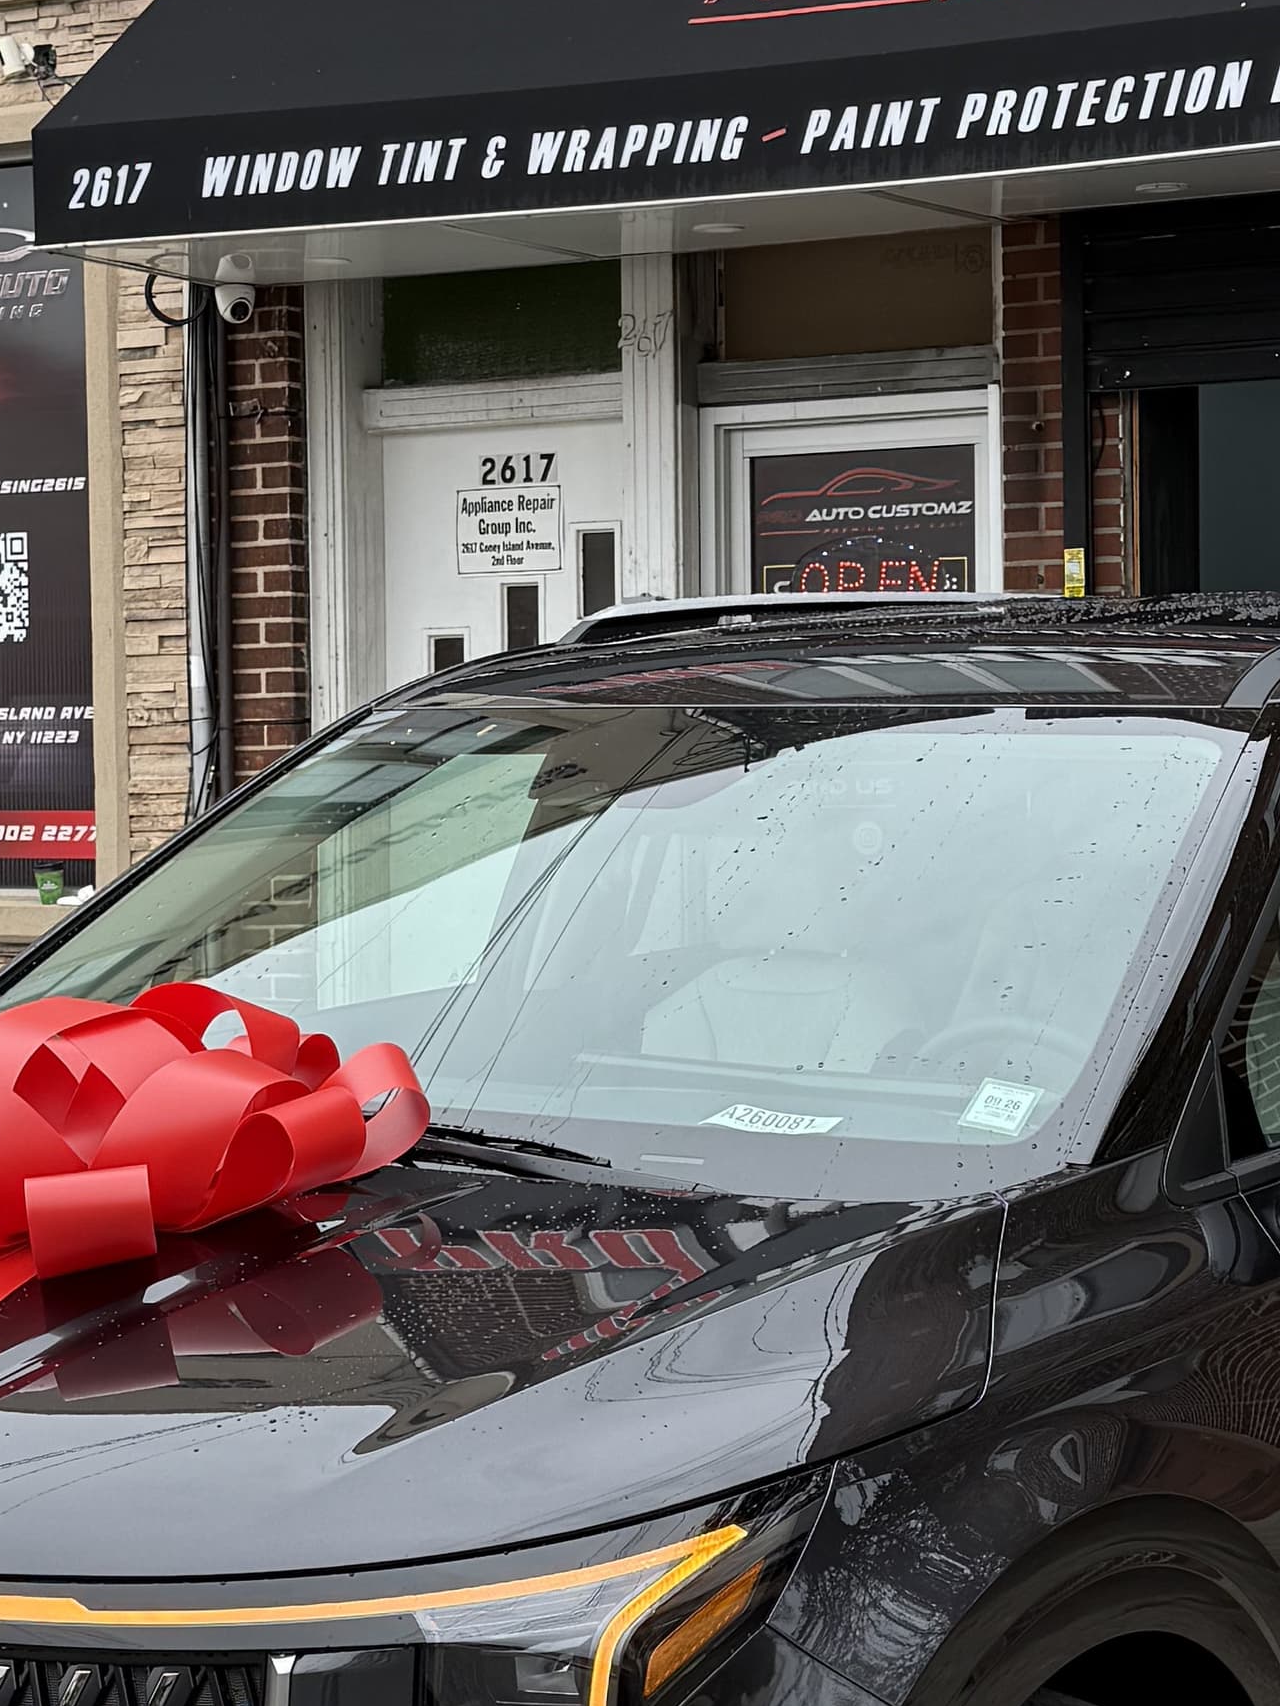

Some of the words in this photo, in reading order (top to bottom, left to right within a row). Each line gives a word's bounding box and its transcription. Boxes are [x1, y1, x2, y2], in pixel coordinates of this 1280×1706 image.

[201, 145, 362, 199] WINDOW
[376, 137, 467, 186] TINT
[479, 134, 503, 180] &
[526, 115, 751, 176] WRAPPING
[798, 96, 942, 154] PAINT
[956, 57, 1255, 137] PROTECTION
[68, 161, 152, 209] 2617
[481, 453, 555, 485] 2617
[461, 496, 514, 517] Appliance
[517, 493, 557, 513] Repair
[805, 507, 865, 521] AUTO
[867, 500, 973, 519] CUSTOMZ
[478, 518, 511, 537] Group
[515, 517, 536, 534] Inc.
[491, 555, 504, 566] 2nd
[506, 555, 524, 565] Floor
[800, 560, 940, 593] OPEN
[60, 705, 95, 720] AVE
[2, 730, 27, 745] NY
[29, 730, 80, 744] 11223
[41, 825, 97, 841] 2277
[722, 1106, 817, 1131] A260081
